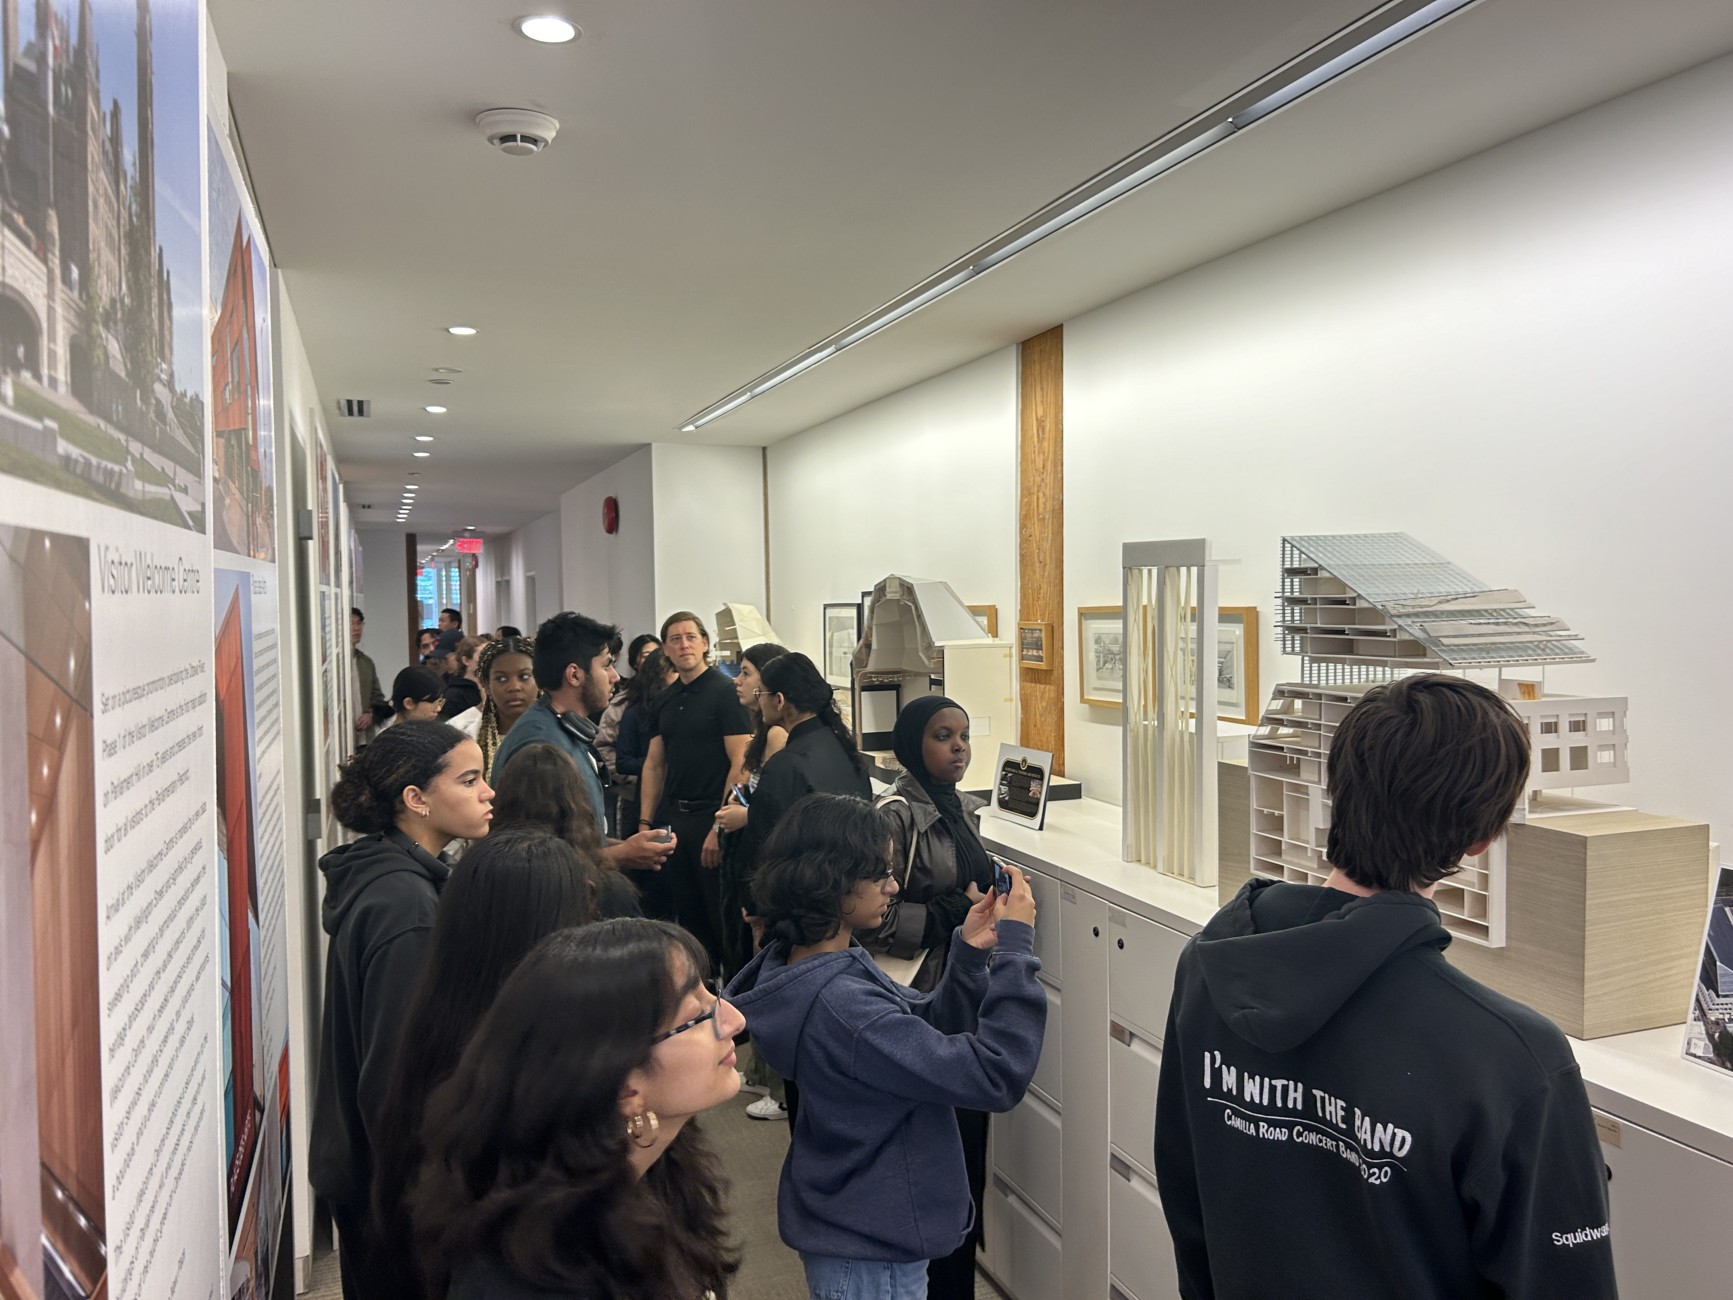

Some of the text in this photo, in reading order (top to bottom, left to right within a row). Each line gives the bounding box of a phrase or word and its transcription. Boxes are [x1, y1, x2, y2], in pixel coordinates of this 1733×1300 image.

[97, 543, 134, 595] Visitor
[134, 550, 177, 595] Welcome
[177, 556, 201, 595] Centre
[1204, 1051, 1412, 1158] I'M WITH THE BAND
[1224, 1108, 1256, 1136] CAMILLA
[1258, 1121, 1289, 1141] ROAD
[1292, 1125, 1337, 1151] CONCERT
[1338, 1141, 1360, 1167] BAND
